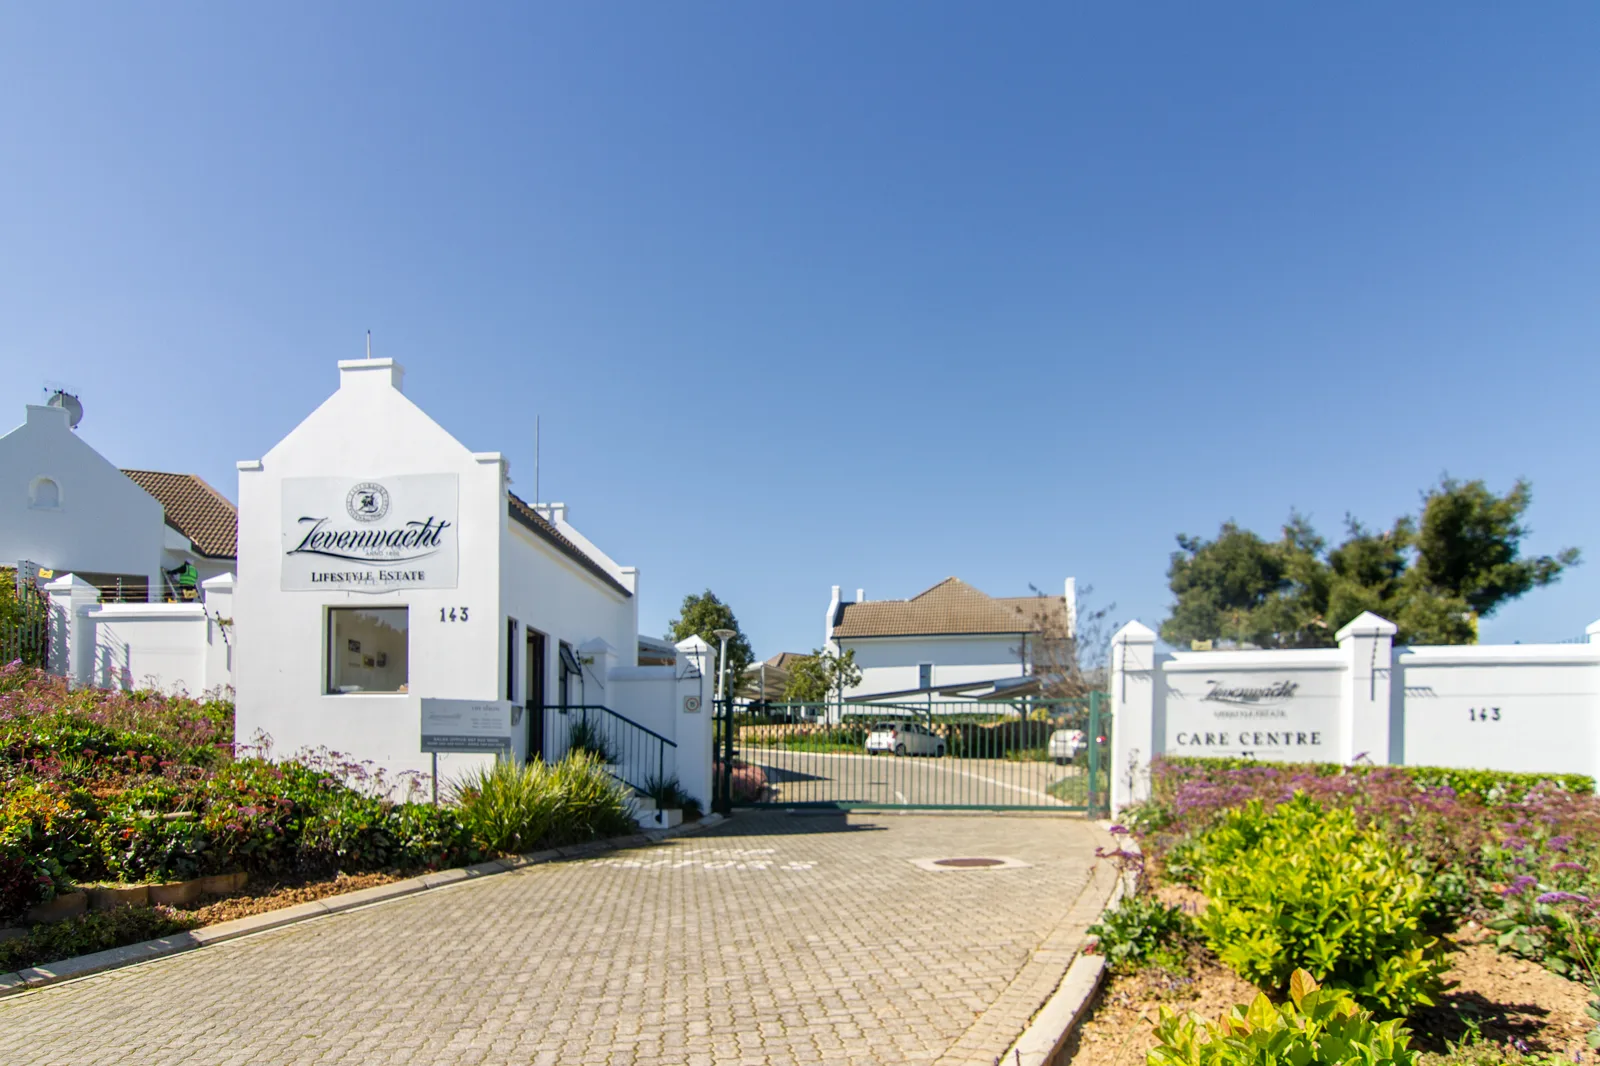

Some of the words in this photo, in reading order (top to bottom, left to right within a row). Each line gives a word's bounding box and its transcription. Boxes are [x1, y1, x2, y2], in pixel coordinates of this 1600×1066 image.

[288, 516, 451, 559] Zevenwacht
[440, 606, 469, 622] 143
[1469, 707, 1501, 722] 143
[1177, 732, 1229, 746] CARE
[1239, 731, 1322, 746] CENTRE
